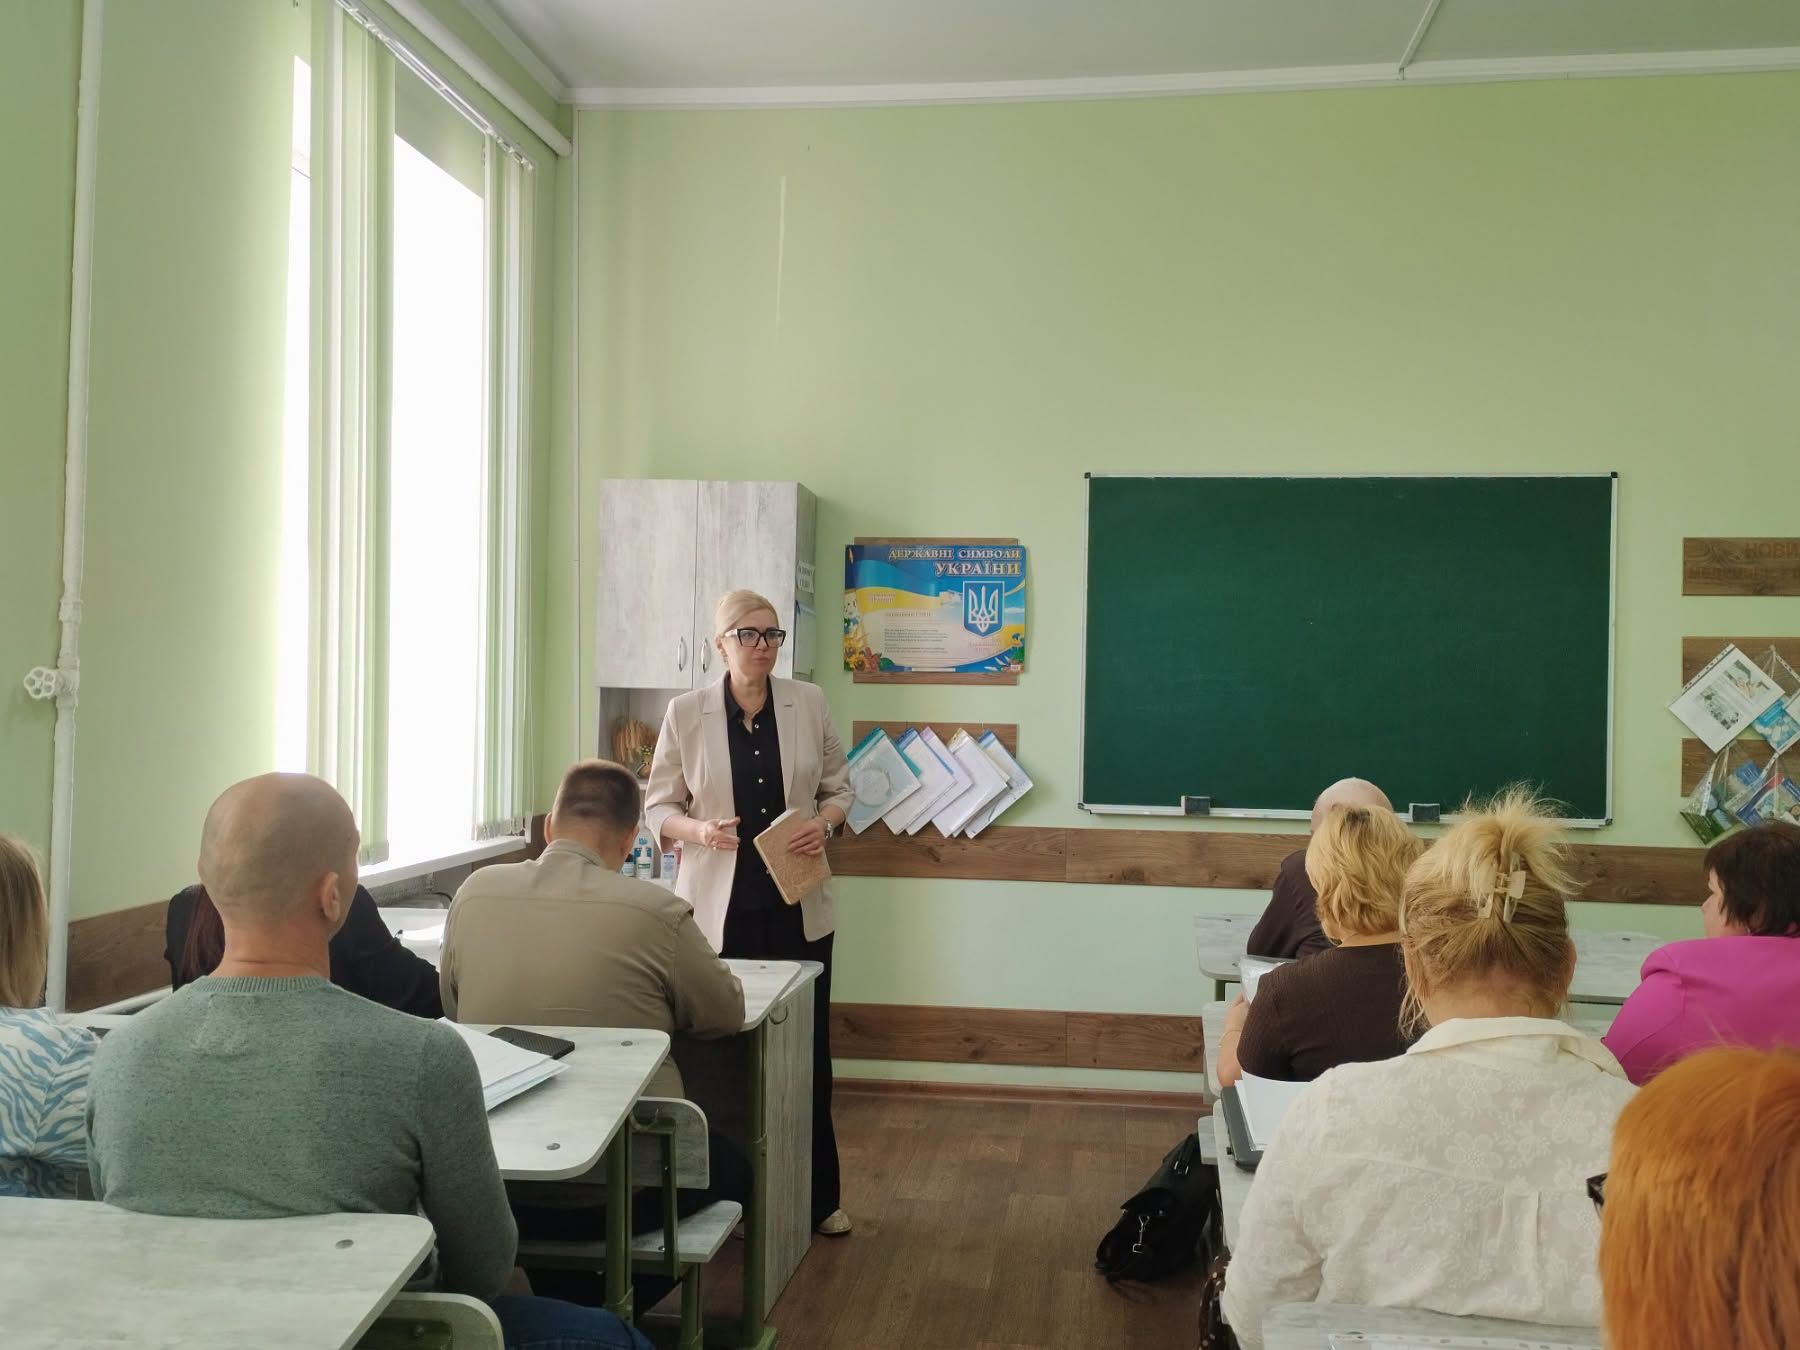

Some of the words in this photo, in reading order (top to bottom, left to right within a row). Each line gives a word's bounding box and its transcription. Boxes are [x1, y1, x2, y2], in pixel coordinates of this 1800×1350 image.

[888, 548, 954, 560] ДЕРЖАВНІ
[958, 549, 1021, 559] СИМВОЛИ
[935, 561, 1021, 576] УКРАЇНИ
